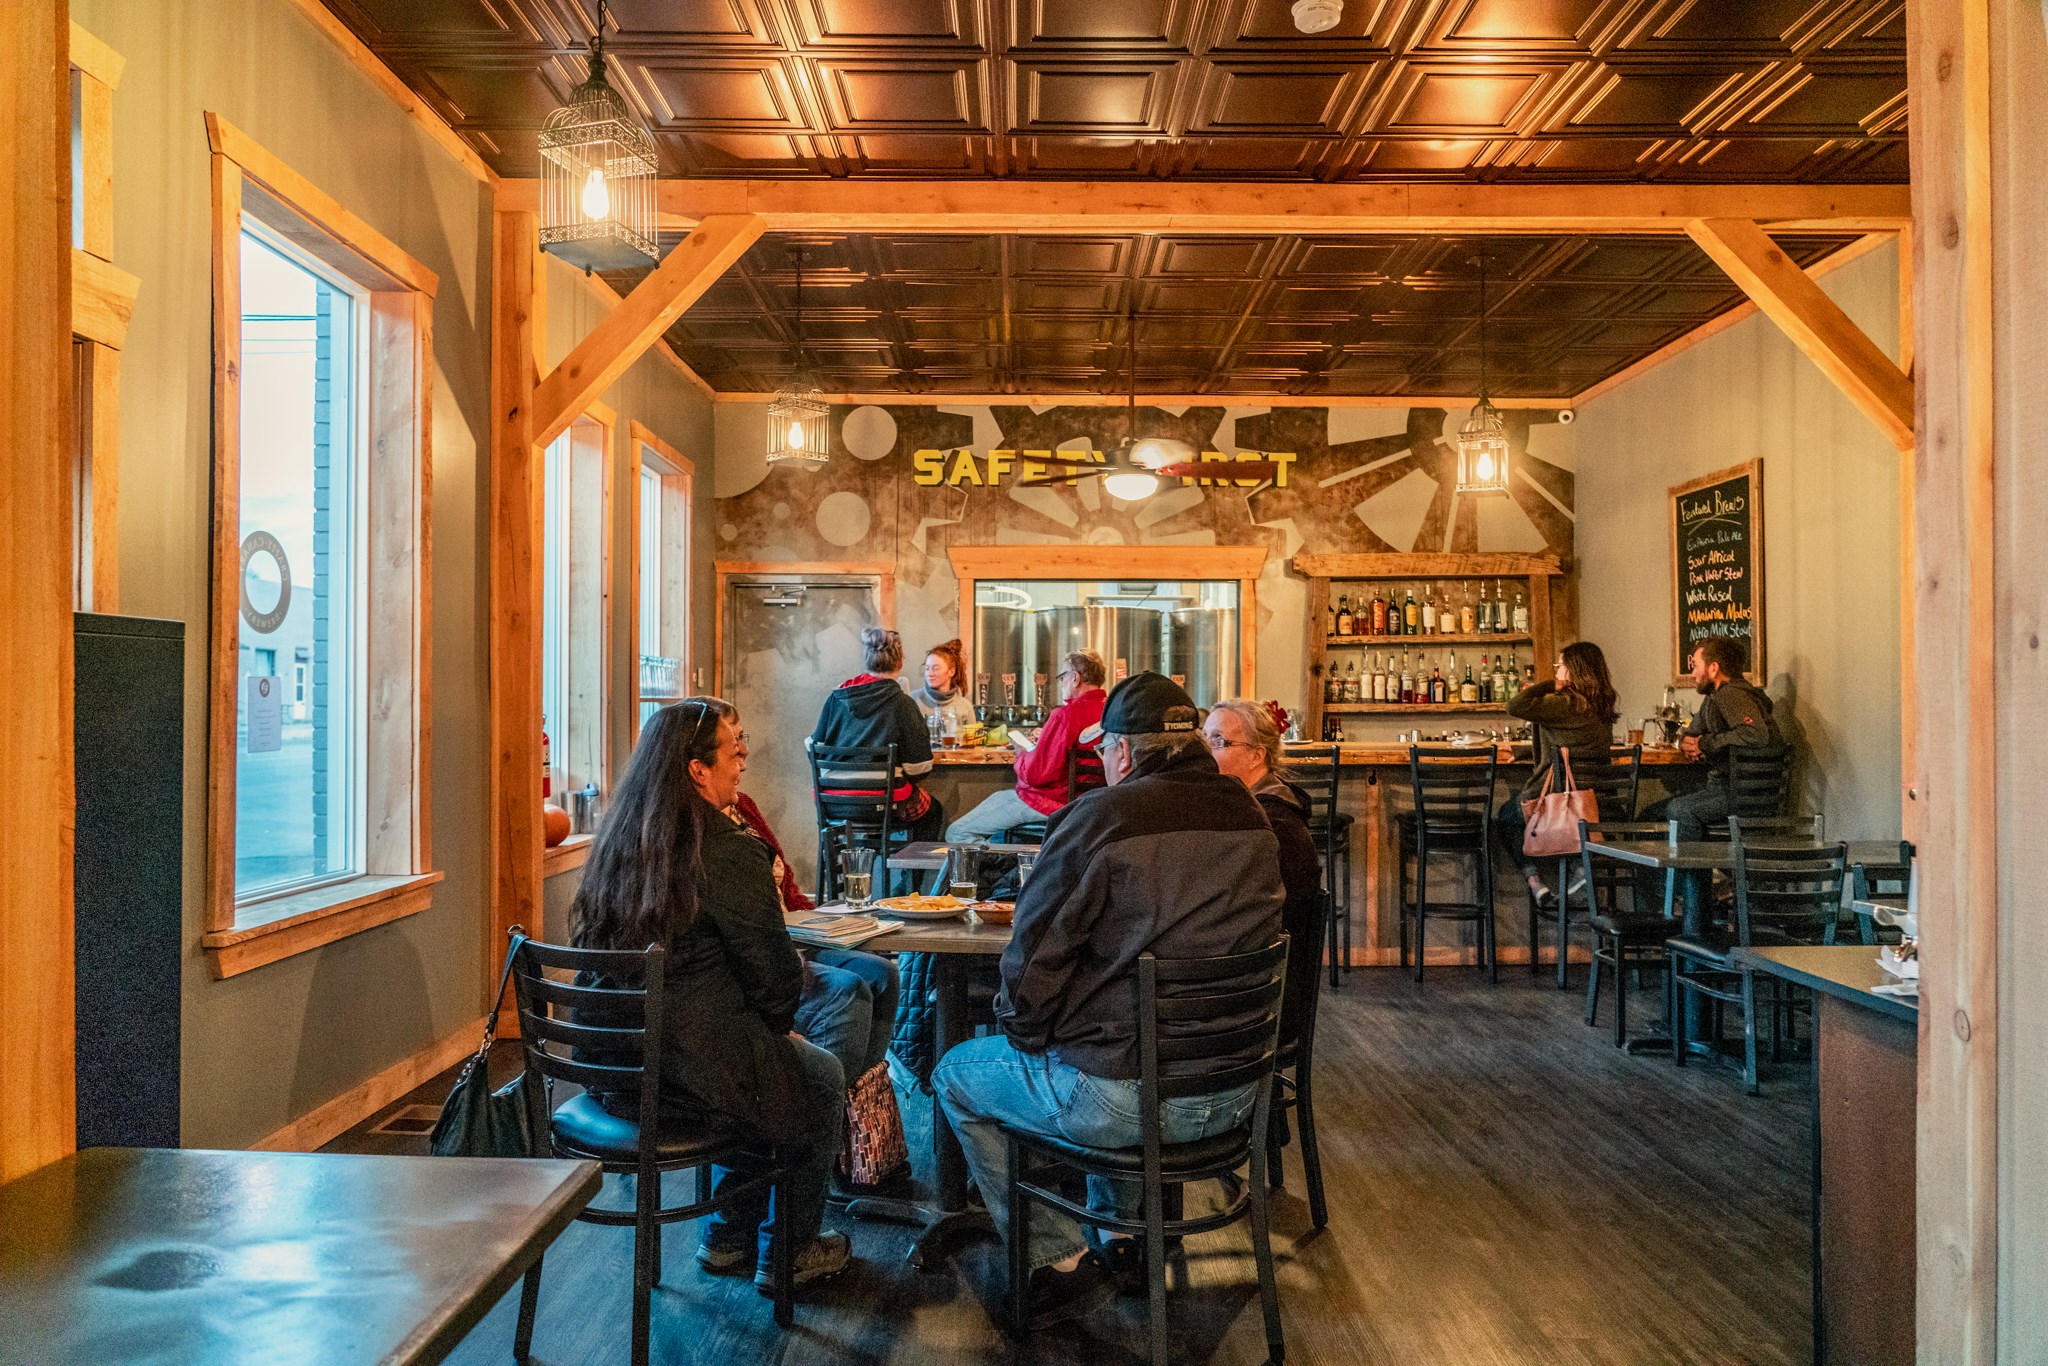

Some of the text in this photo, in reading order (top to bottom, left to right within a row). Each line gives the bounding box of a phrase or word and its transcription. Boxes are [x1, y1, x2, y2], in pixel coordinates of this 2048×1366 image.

[1178, 452, 1298, 488] IRST
[1714, 490, 1745, 516] Brews
[1685, 584, 1733, 606] White Rascal
[1709, 621, 1729, 638] Milk
[1729, 622, 1752, 639] Stout
[1163, 721, 1193, 731] WYOMING
